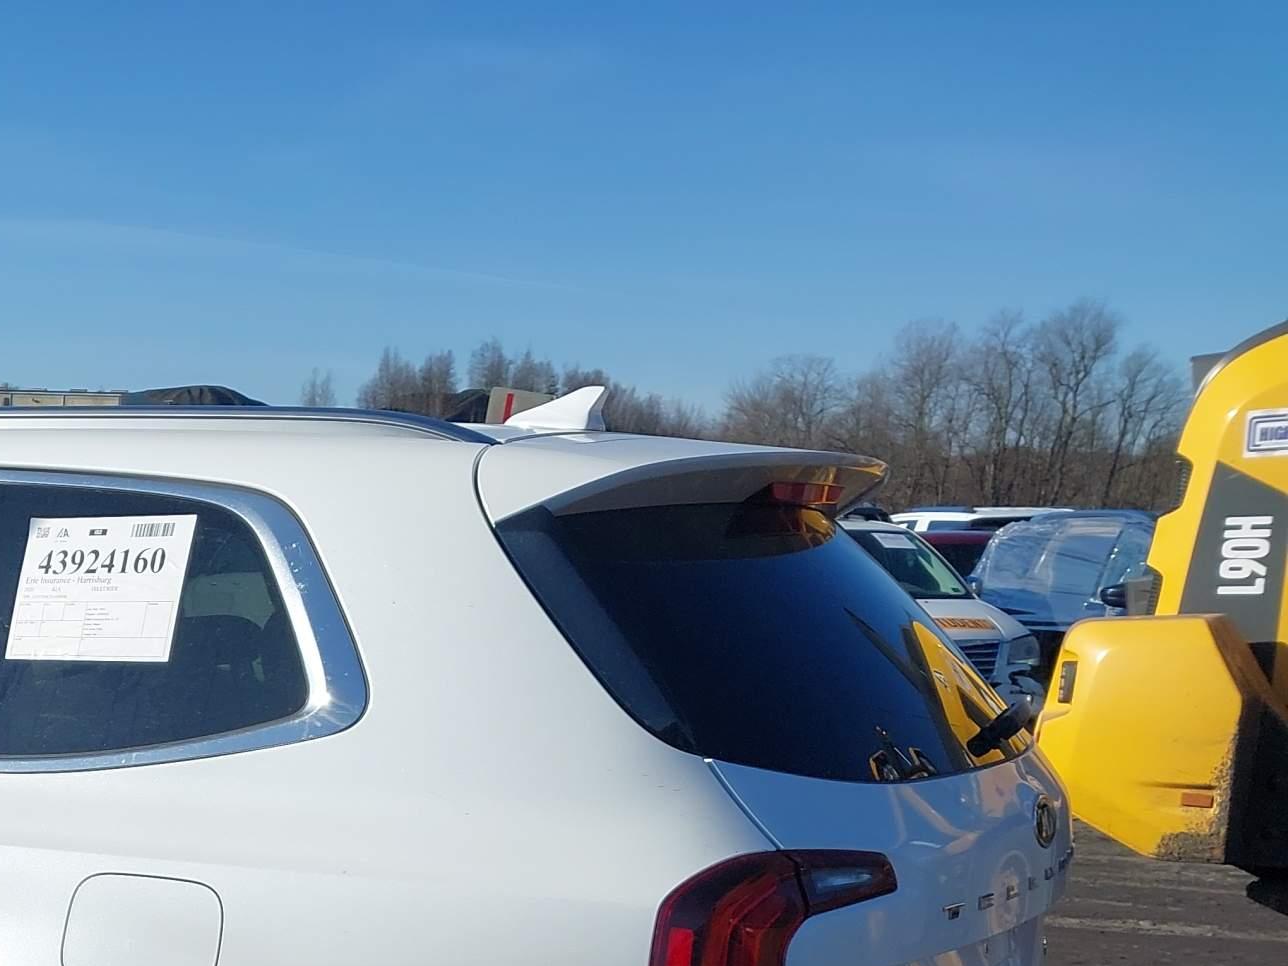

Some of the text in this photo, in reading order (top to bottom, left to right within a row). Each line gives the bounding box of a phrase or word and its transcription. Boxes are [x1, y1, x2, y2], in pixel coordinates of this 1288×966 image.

[38, 547, 166, 575] 43924160
[1216, 515, 1274, 595] L90H
[40, 576, 71, 585] Insurance
[77, 575, 112, 585] Harrisburg
